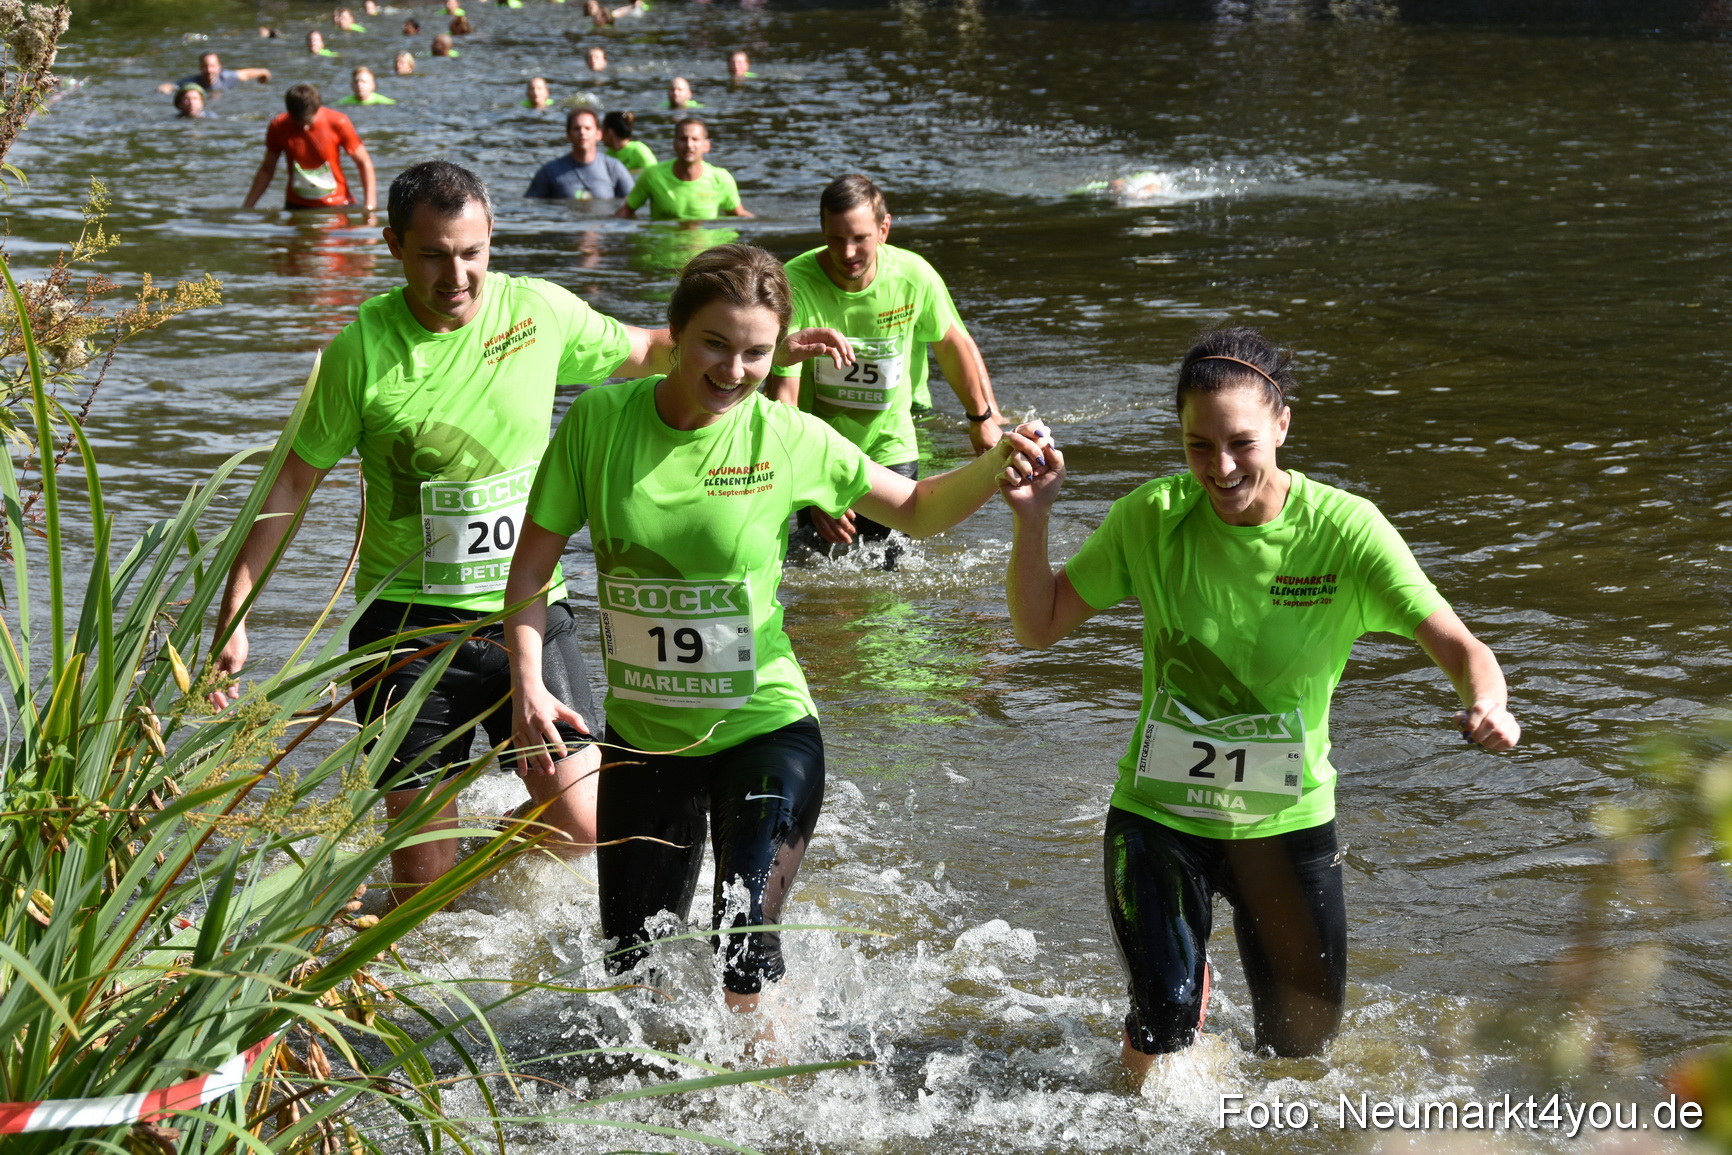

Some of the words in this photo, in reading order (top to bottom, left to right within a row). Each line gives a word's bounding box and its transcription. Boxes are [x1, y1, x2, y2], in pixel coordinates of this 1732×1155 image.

[484, 318, 533, 348] NEUMARKTER
[484, 325, 536, 358] ELEMENTELAUF
[844, 362, 878, 384] 25
[838, 389, 882, 401] PETER
[704, 471, 775, 486] ELEMENTELAUF
[708, 461, 770, 476] NEUMARKTER
[432, 470, 531, 512] BOCK
[718, 488, 755, 497] September
[757, 484, 773, 493] 2019
[468, 516, 515, 554] 20
[460, 562, 510, 581] PETE
[1276, 574, 1337, 585] NEUMARKTER
[605, 581, 738, 615] BOCK
[648, 626, 703, 663] 19
[625, 669, 733, 694] MARLENE
[1189, 741, 1246, 782] 21
[1187, 789, 1246, 810] NINA
